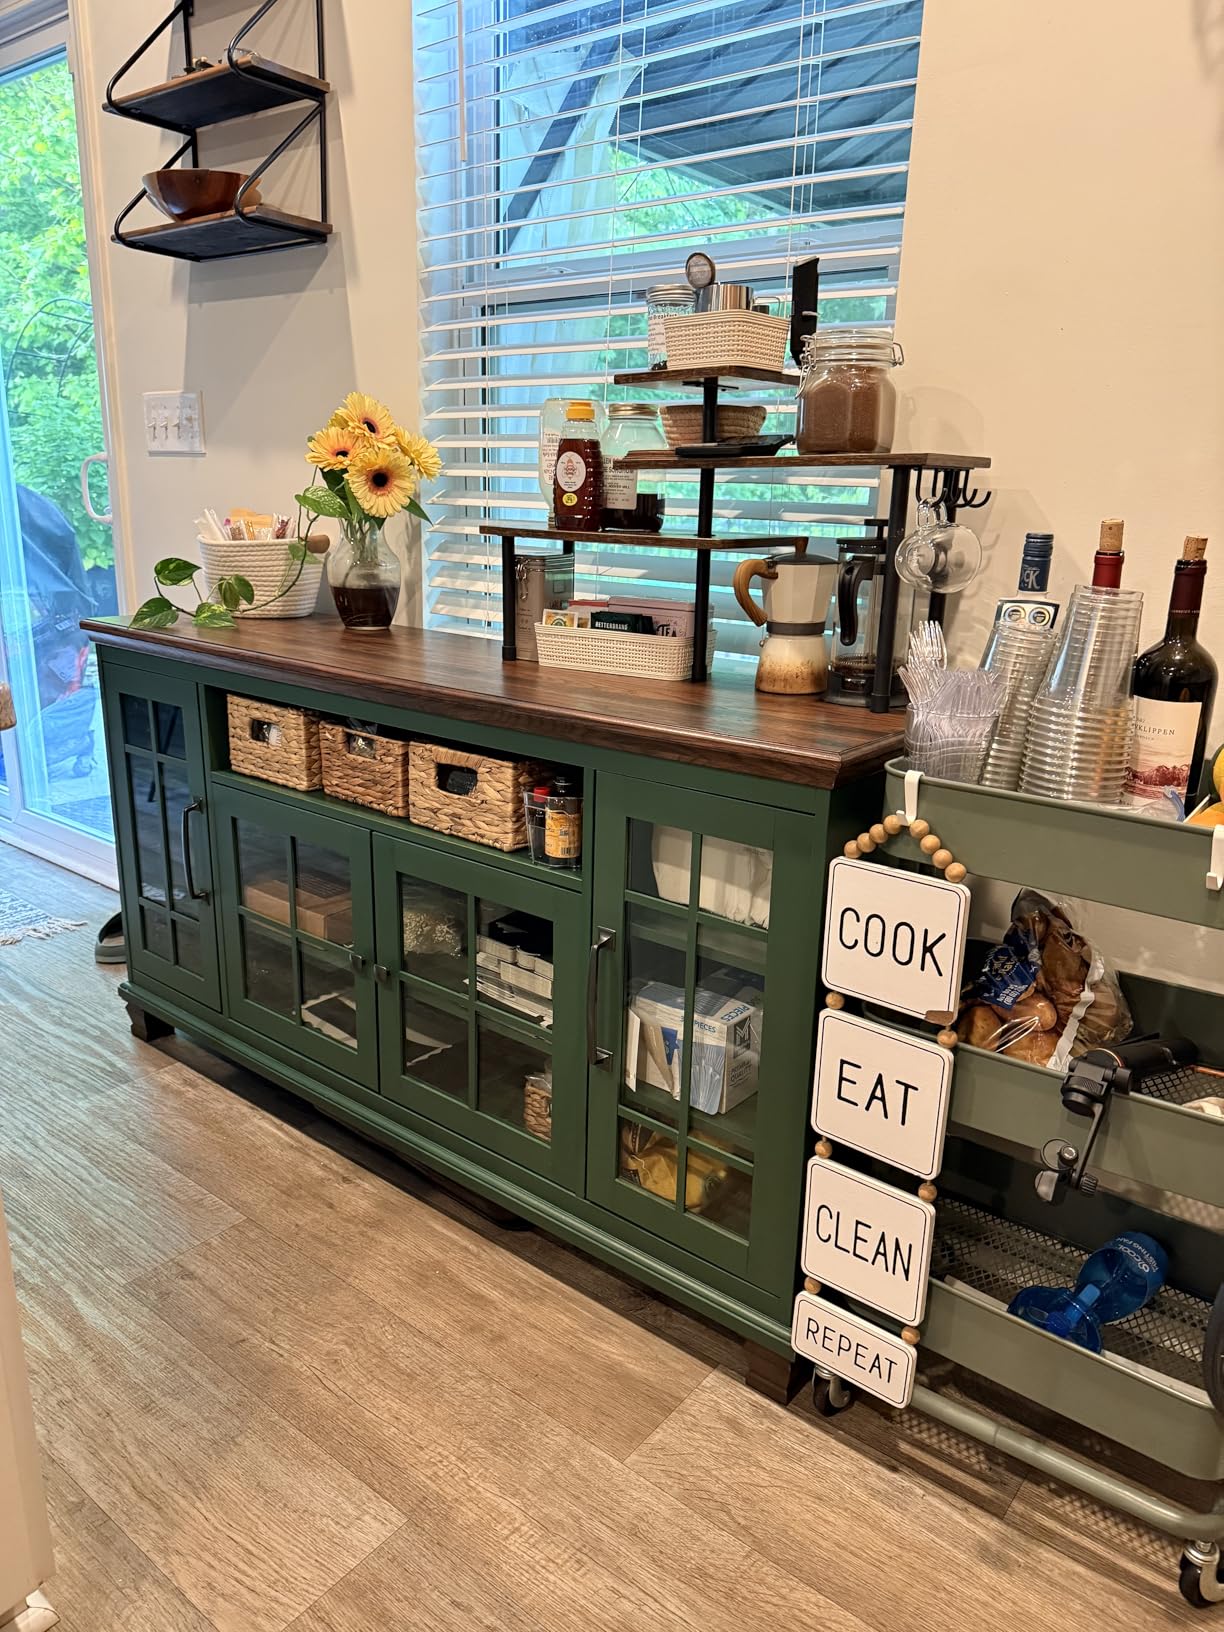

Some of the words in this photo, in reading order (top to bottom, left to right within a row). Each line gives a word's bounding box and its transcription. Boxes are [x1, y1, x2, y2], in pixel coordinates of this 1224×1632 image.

[839, 907, 946, 977] COOK
[694, 1020, 716, 1033] PIECES
[721, 1005, 750, 1022] PIECES
[837, 1058, 919, 1126] EAT
[815, 1204, 912, 1282] CLEAN
[806, 1317, 897, 1384] REPEAT
